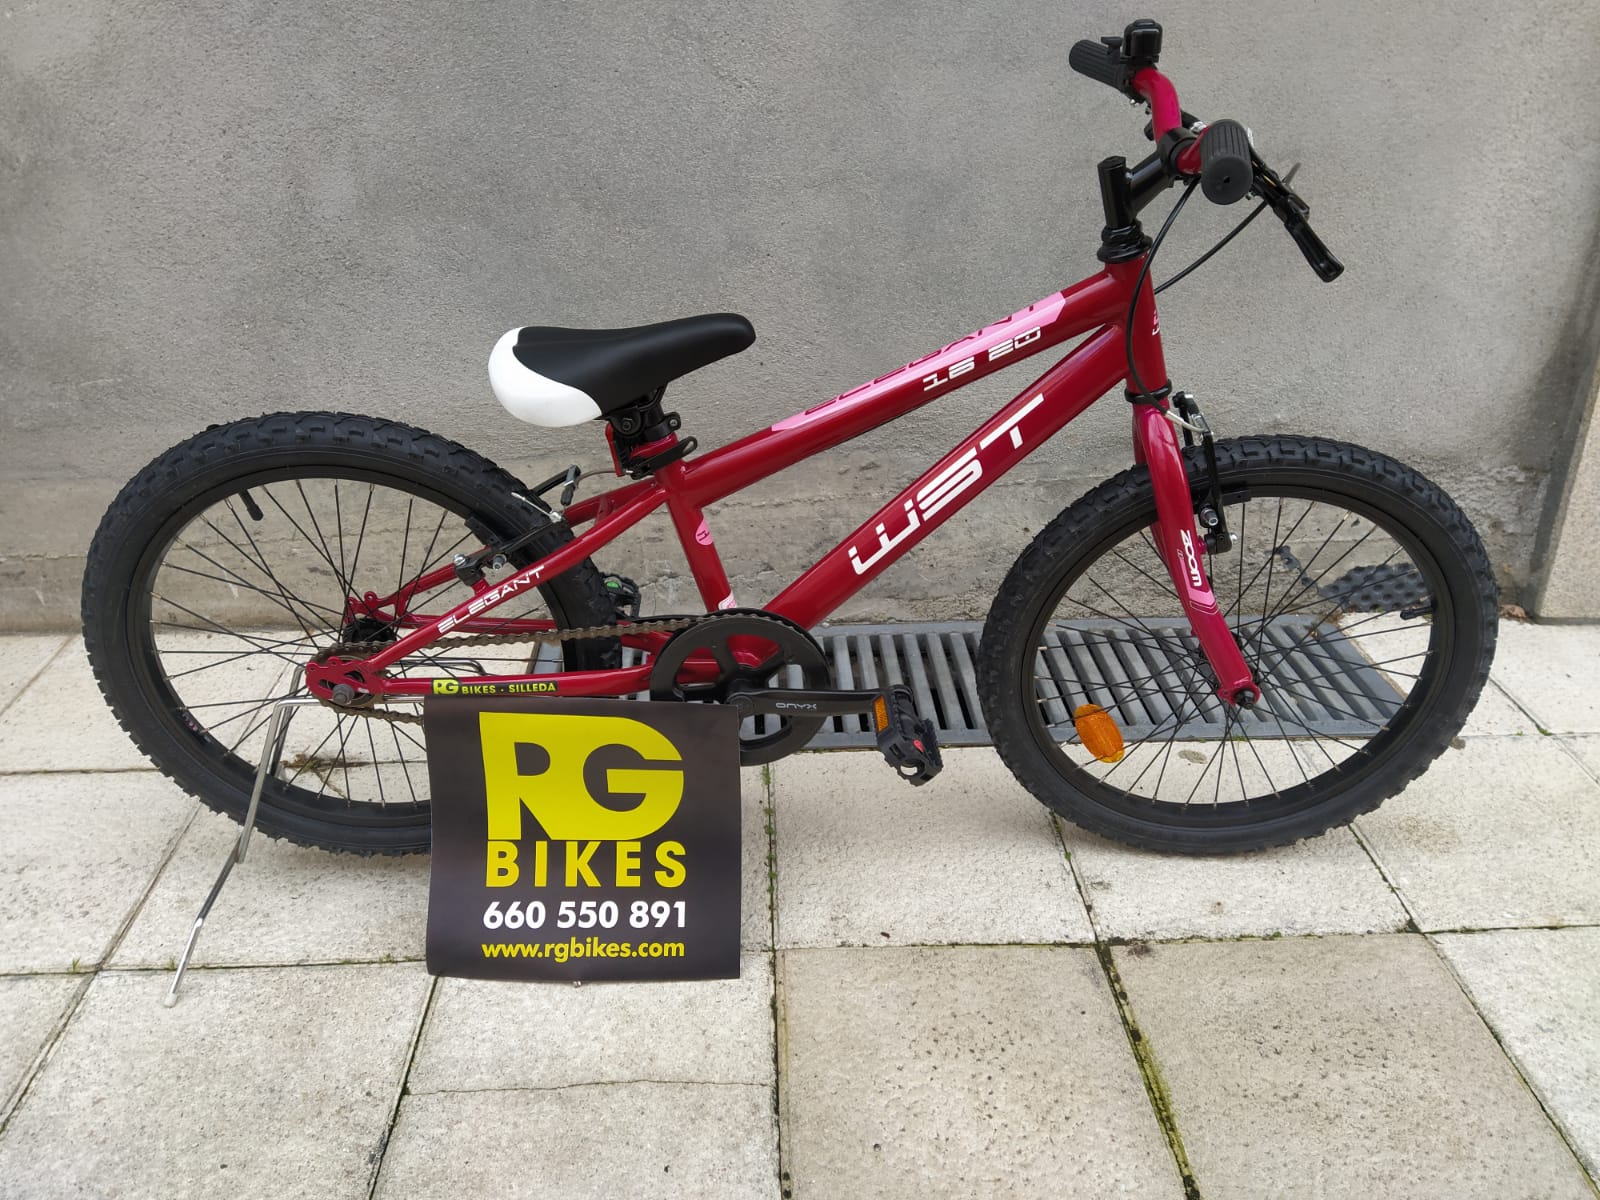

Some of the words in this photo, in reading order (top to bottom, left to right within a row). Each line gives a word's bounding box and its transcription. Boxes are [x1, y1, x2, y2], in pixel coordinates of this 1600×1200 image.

[436, 564, 545, 634] ELEGANT
[432, 679, 460, 695] RG
[461, 685, 497, 695] BIKES
[508, 682, 556, 693] SILLEDA
[479, 711, 685, 841] RG
[485, 840, 687, 888] BIKES
[482, 900, 546, 929] 660
[556, 900, 619, 928] 550
[628, 900, 686, 928] 891
[481, 936, 685, 963] www.rgbikes.com
